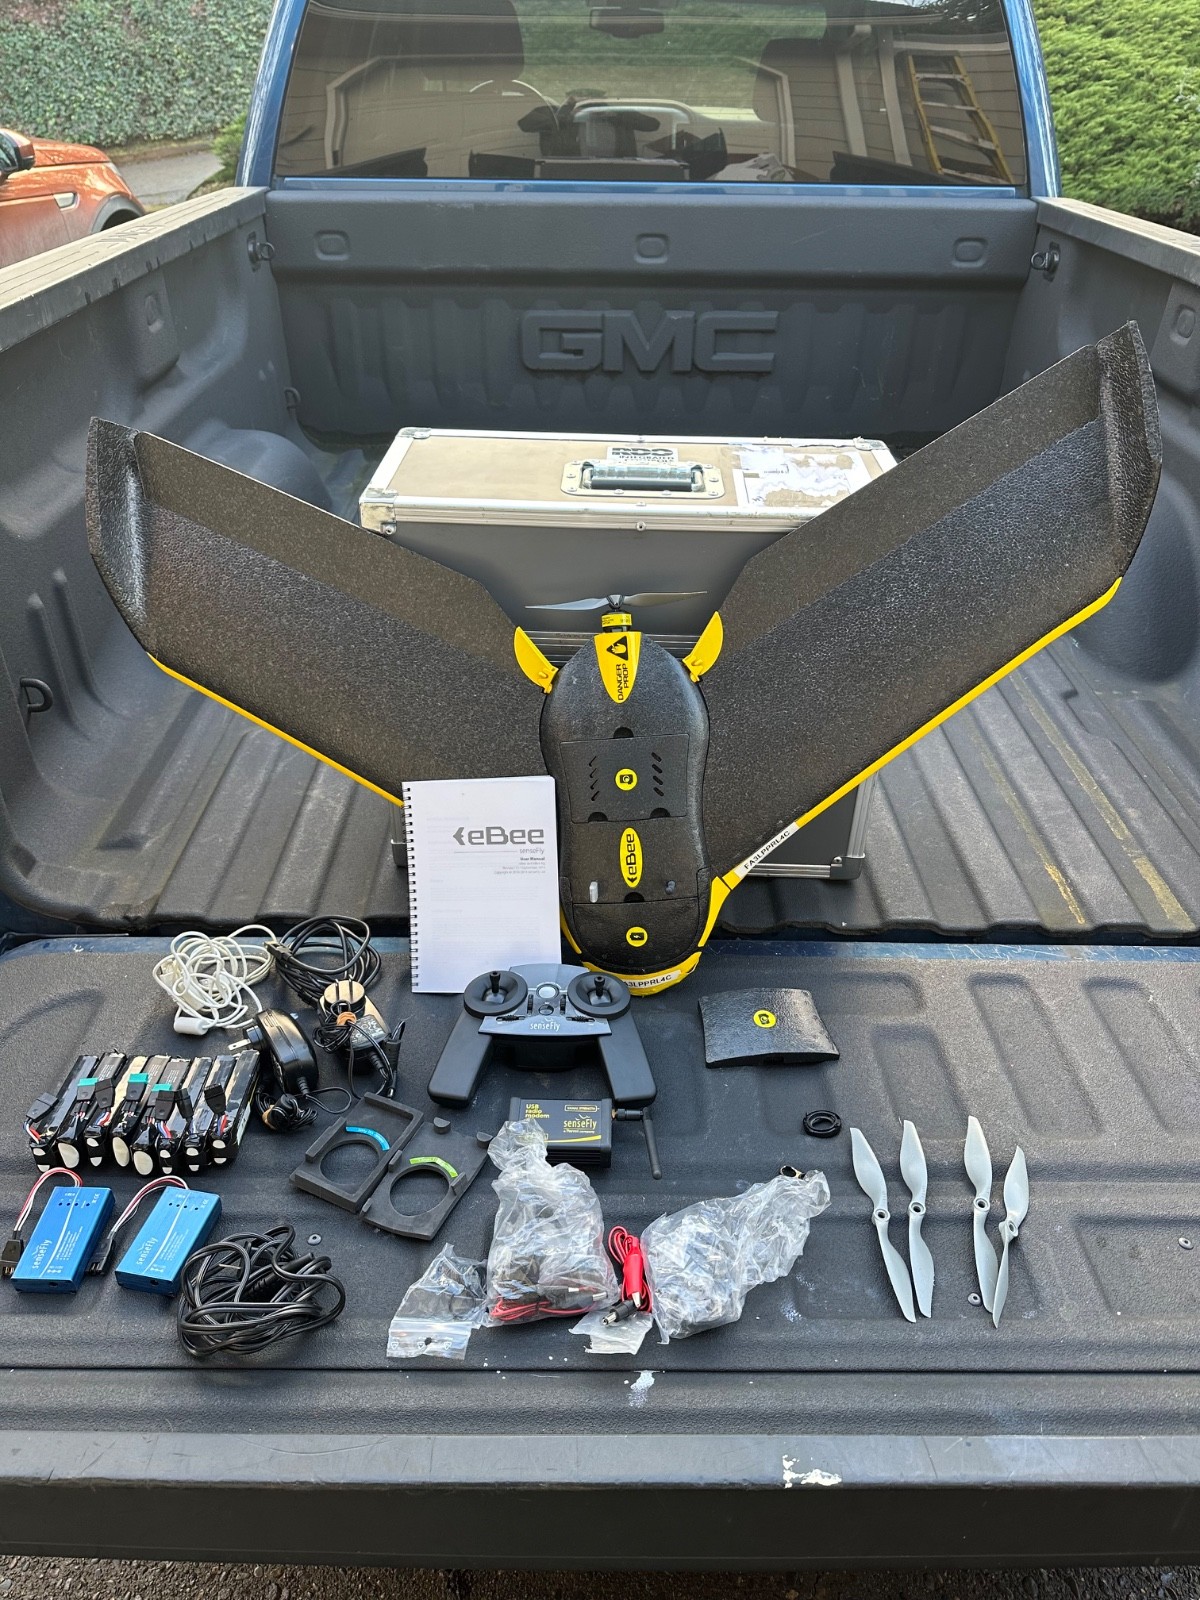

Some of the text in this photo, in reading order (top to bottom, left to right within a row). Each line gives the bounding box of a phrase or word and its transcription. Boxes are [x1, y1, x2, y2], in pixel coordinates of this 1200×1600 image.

[521, 309, 780, 373] GMC
[616, 664, 624, 700] DANGER
[467, 826, 545, 845] eBee
[626, 834, 637, 875] eBee
[744, 831, 790, 870] FA3LPPRL4C
[623, 974, 672, 987] A3LPPRL4C
[530, 1021, 560, 1032] senseFly
[563, 1118, 597, 1130] senseFly
[32, 1239, 53, 1269] senseFly
[136, 1237, 158, 1265] senseFly
